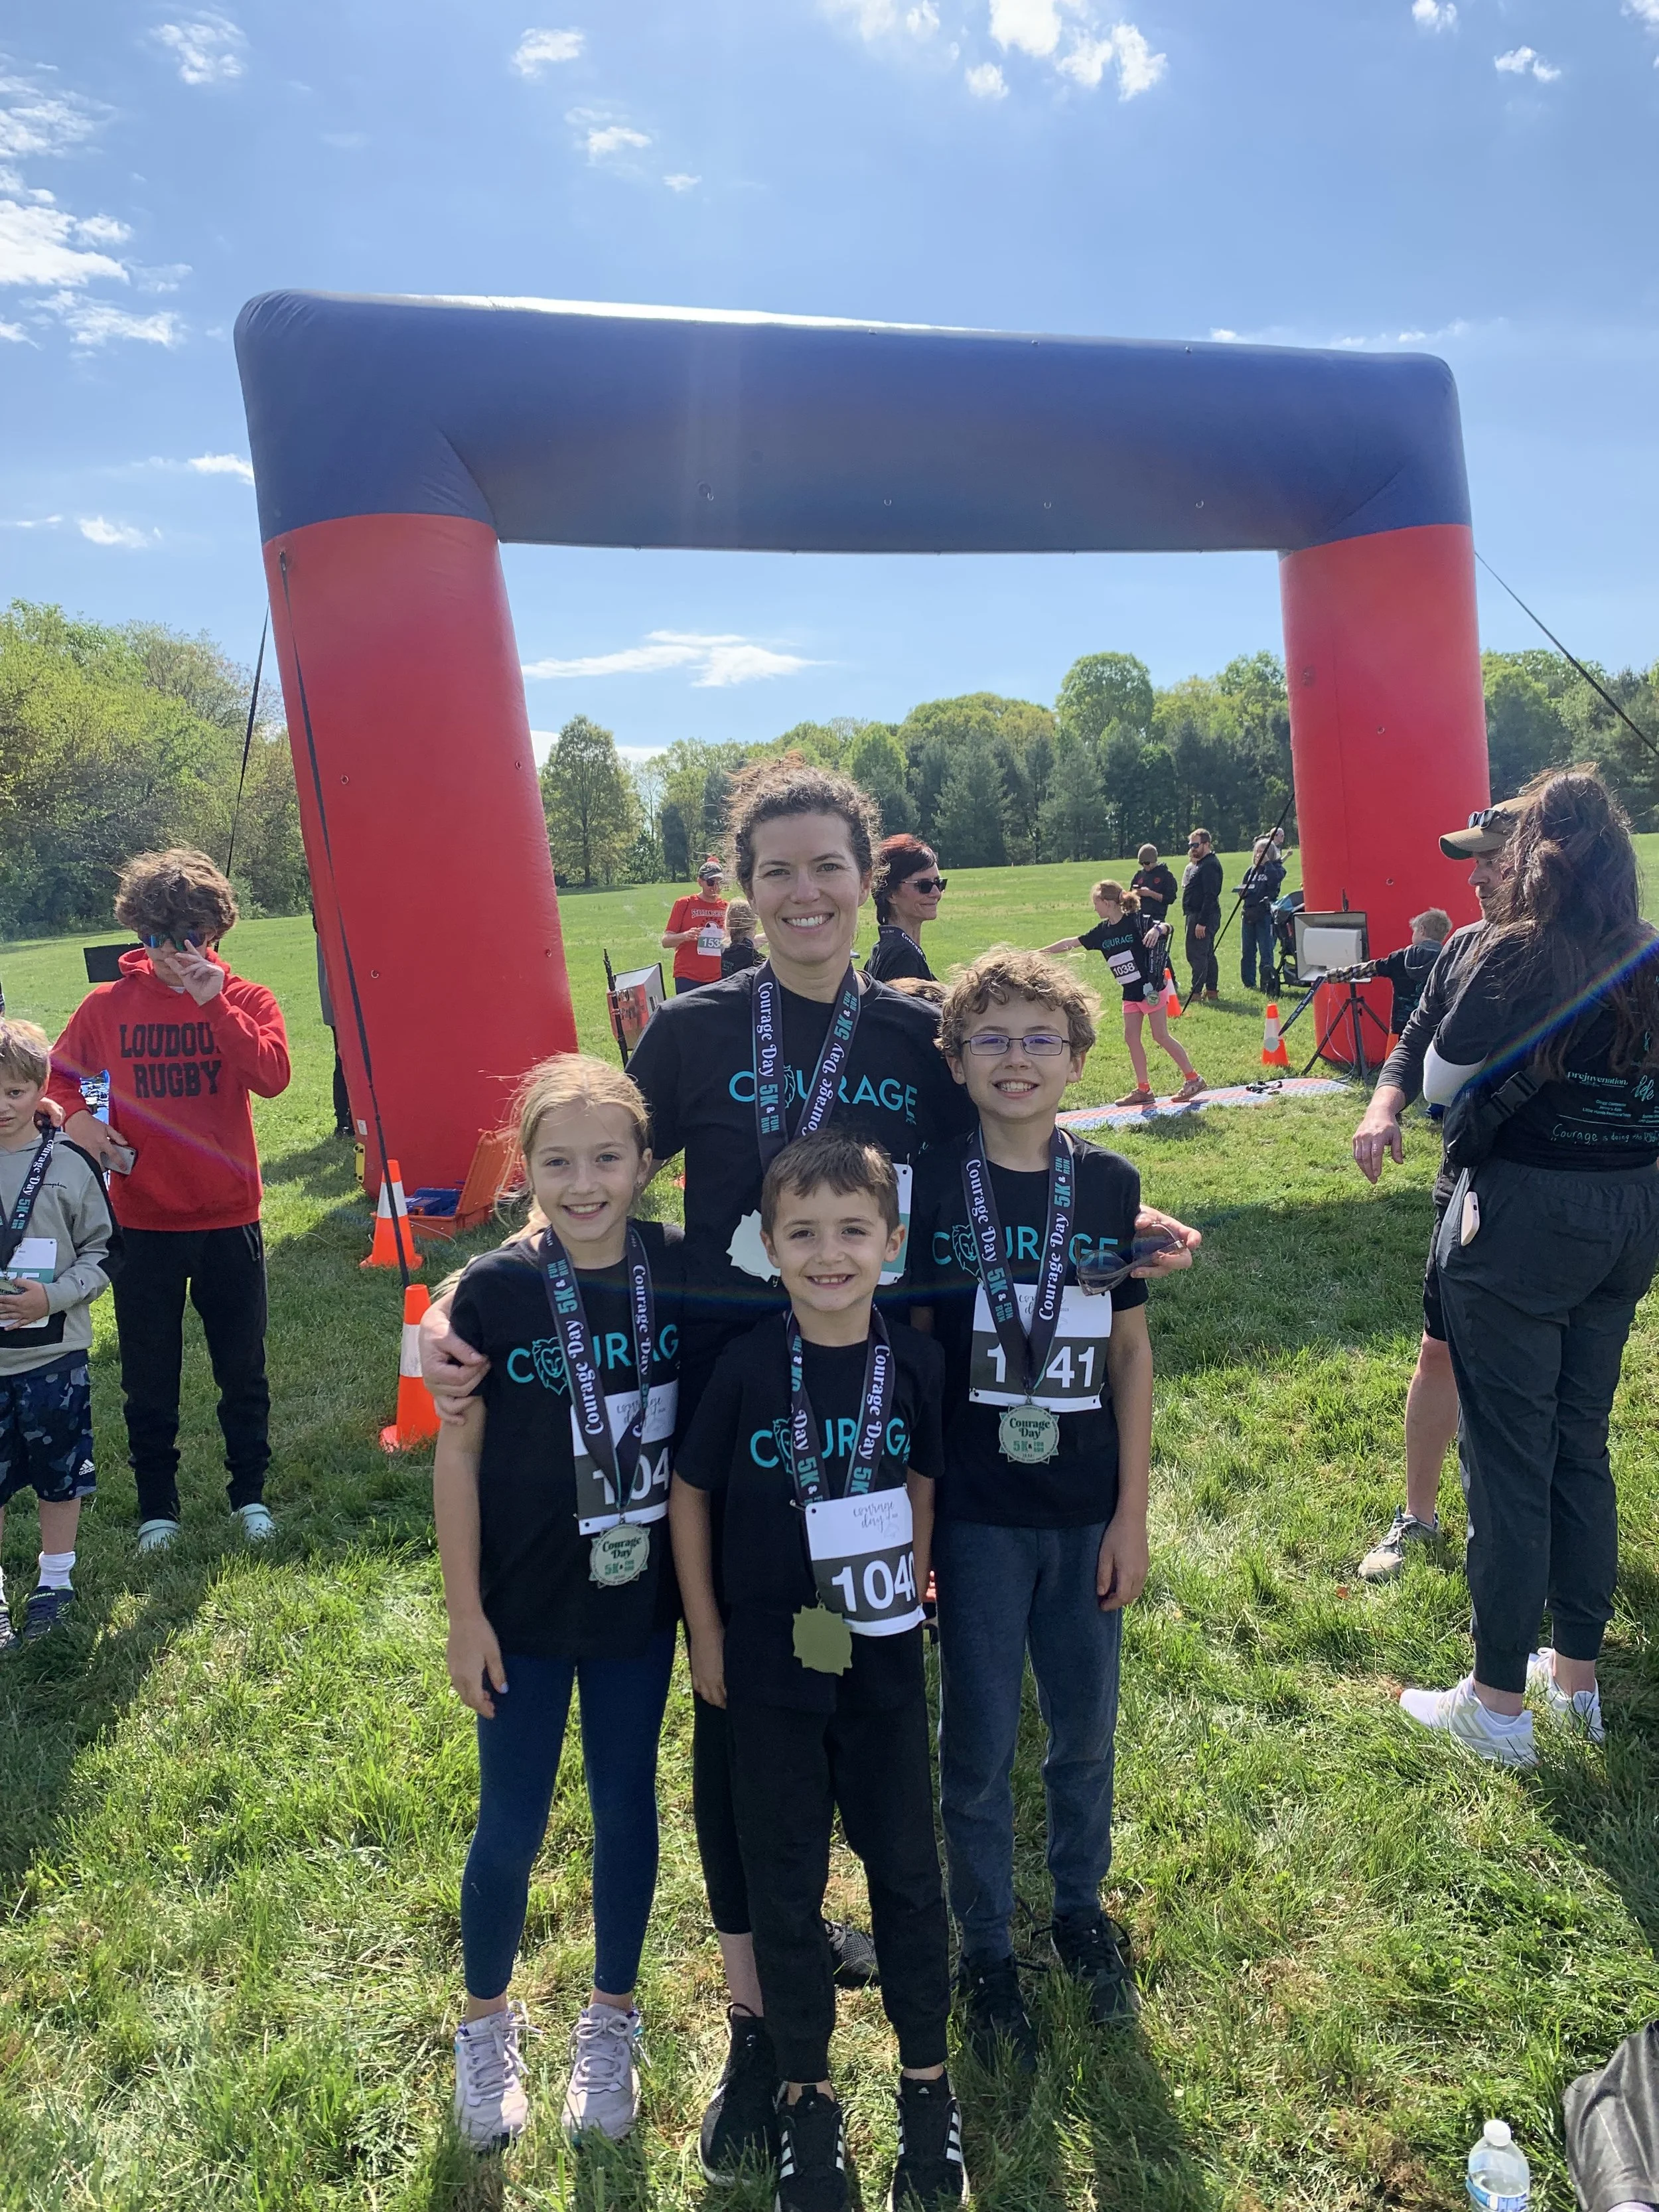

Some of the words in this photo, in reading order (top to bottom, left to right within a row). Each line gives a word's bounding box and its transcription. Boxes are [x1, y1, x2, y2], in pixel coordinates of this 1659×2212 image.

[1114, 962, 1135, 976] 1038
[757, 981, 774, 1041] Courage
[843, 990, 852, 1006] FUN
[849, 995, 858, 1012] RUN
[120, 1022, 221, 1058] LOUDOU
[833, 1013, 854, 1041] 5K
[758, 1043, 778, 1077] Day
[822, 1043, 845, 1074] Day
[133, 1059, 222, 1098] RUGBY
[759, 1084, 778, 1108] 5K
[802, 1078, 833, 1136] Courage
[760, 1117, 771, 1134] RUN
[770, 1114, 779, 1132] FUN
[1552, 1124, 1597, 1145] Courage
[1611, 1132, 1630, 1142] doing
[23, 1175, 40, 1195] Day
[966, 1159, 989, 1224] Courage
[1054, 1182, 1070, 1208] 5K
[17, 1198, 31, 1213] 5K
[1050, 1213, 1070, 1248] Day
[981, 1226, 997, 1262] Day
[547, 1263, 559, 1279] FUN
[557, 1259, 569, 1276] RUN
[555, 1280, 566, 1288] &
[987, 1267, 1010, 1295] 5K
[1039, 1252, 1063, 1321] Courage
[553, 1285, 578, 1314] 5K
[633, 1264, 650, 1333] Courage
[1003, 1302, 1014, 1319] FUN
[995, 1306, 1005, 1322] RUN
[565, 1320, 585, 1359] Day
[640, 1337, 652, 1376] Day
[793, 1356, 802, 1364] &
[987, 1343, 1095, 1388] 141
[866, 1344, 890, 1416] Courage
[575, 1361, 604, 1436] Courage
[793, 1409, 810, 1451] Day
[1010, 1418, 1050, 1431] Courage
[1019, 1428, 1041, 1439] Day
[858, 1420, 883, 1460] Day
[1013, 1441, 1028, 1451] 5K
[797, 1455, 820, 1487] 5K
[851, 1467, 873, 1494] 5K
[808, 1485, 818, 1495] &
[853, 1501, 895, 1517] courage
[861, 1515, 884, 1532] day
[603, 1536, 641, 1552] Courage
[611, 1548, 632, 1559] Day
